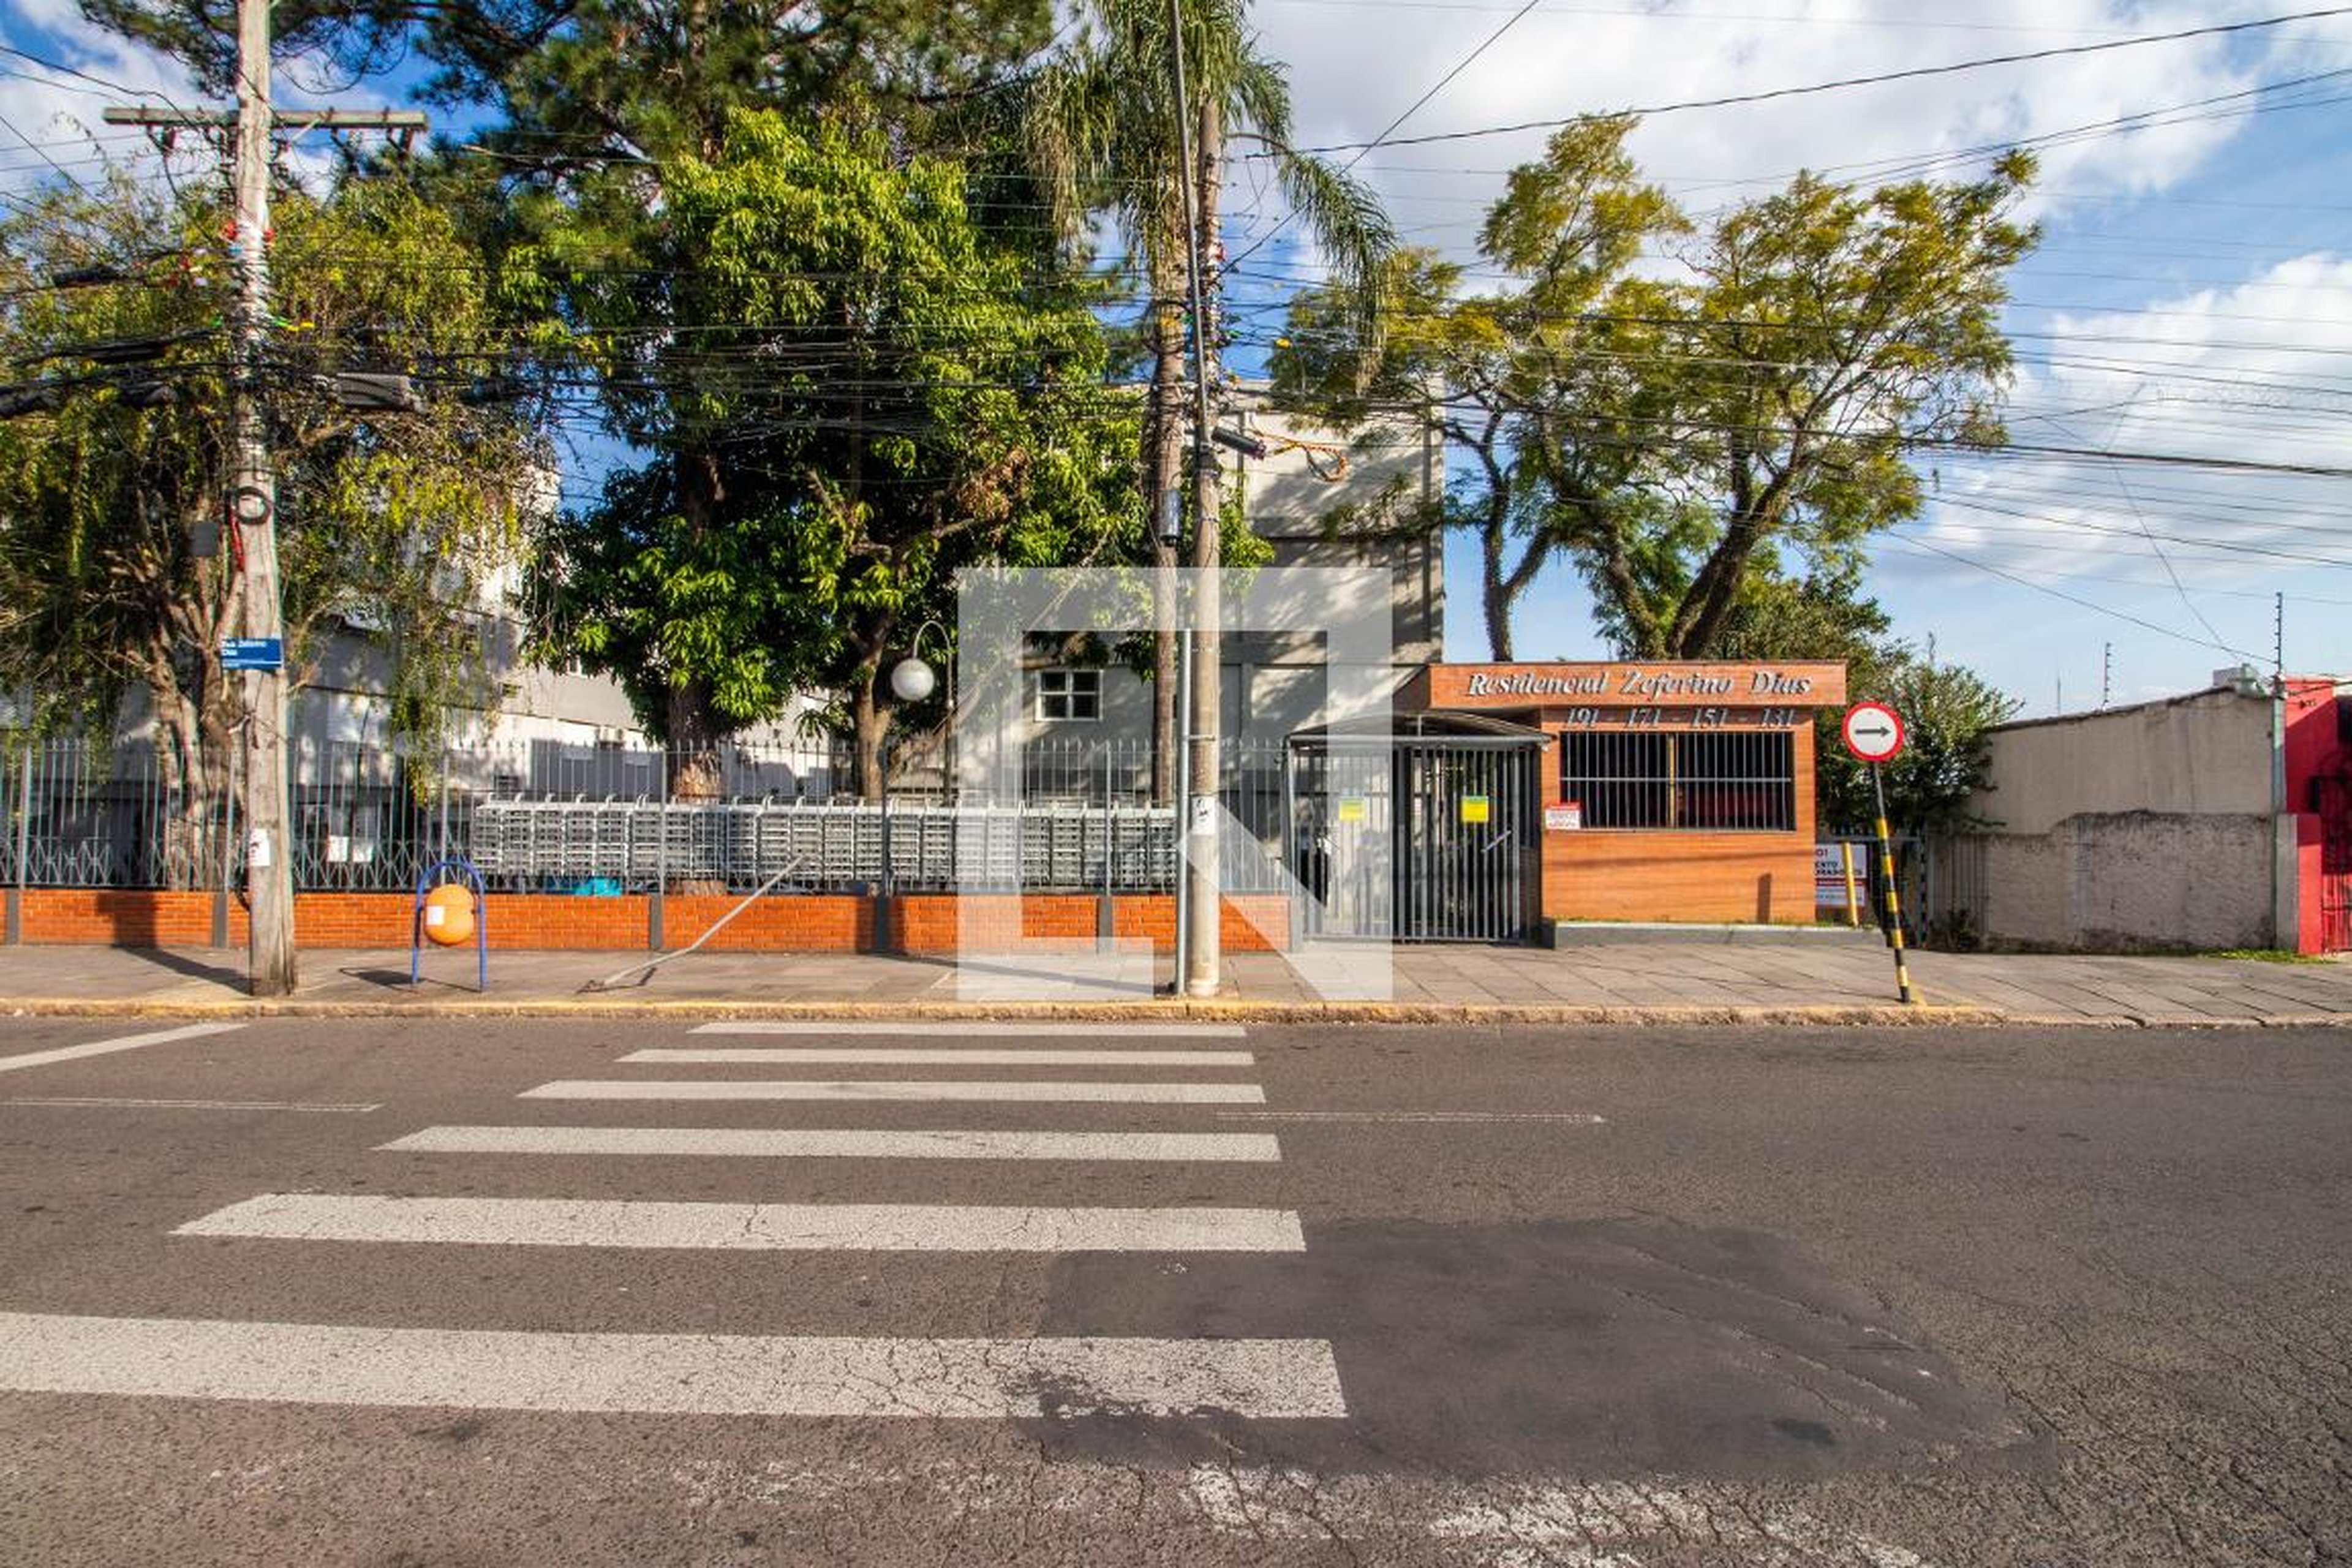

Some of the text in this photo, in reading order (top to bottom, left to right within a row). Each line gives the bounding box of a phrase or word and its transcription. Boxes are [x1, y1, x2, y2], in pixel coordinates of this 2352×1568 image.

[1466, 670, 1812, 701] Residencial Zeferino Dias
[1564, 707, 1600, 728] 191
[1624, 707, 1662, 728] 171
[1691, 707, 1728, 728] 151
[1759, 708, 1795, 728] 131
